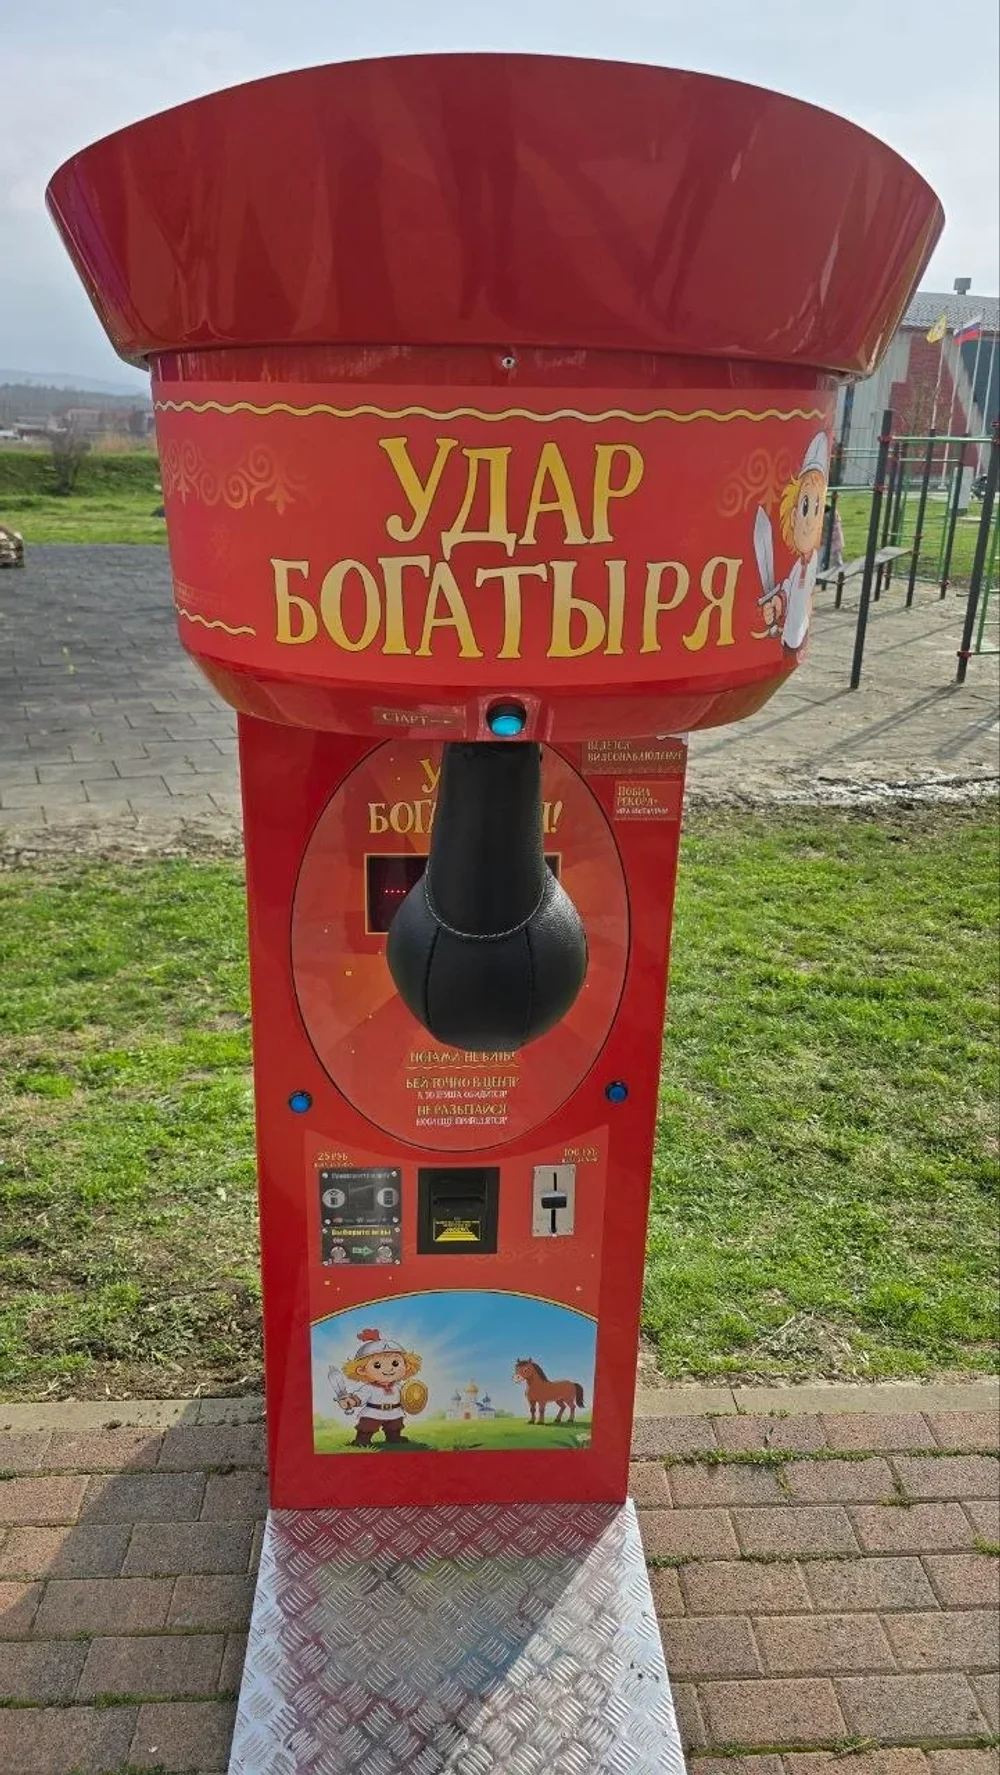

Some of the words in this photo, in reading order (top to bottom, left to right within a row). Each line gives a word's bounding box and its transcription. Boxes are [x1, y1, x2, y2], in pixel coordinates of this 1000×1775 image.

[378, 436, 645, 561] УДАР
[270, 555, 744, 659] БОГАТЫРЯ
[382, 711, 429, 726] СТАРТ
[432, 1077, 470, 1088] ТОЧНО
